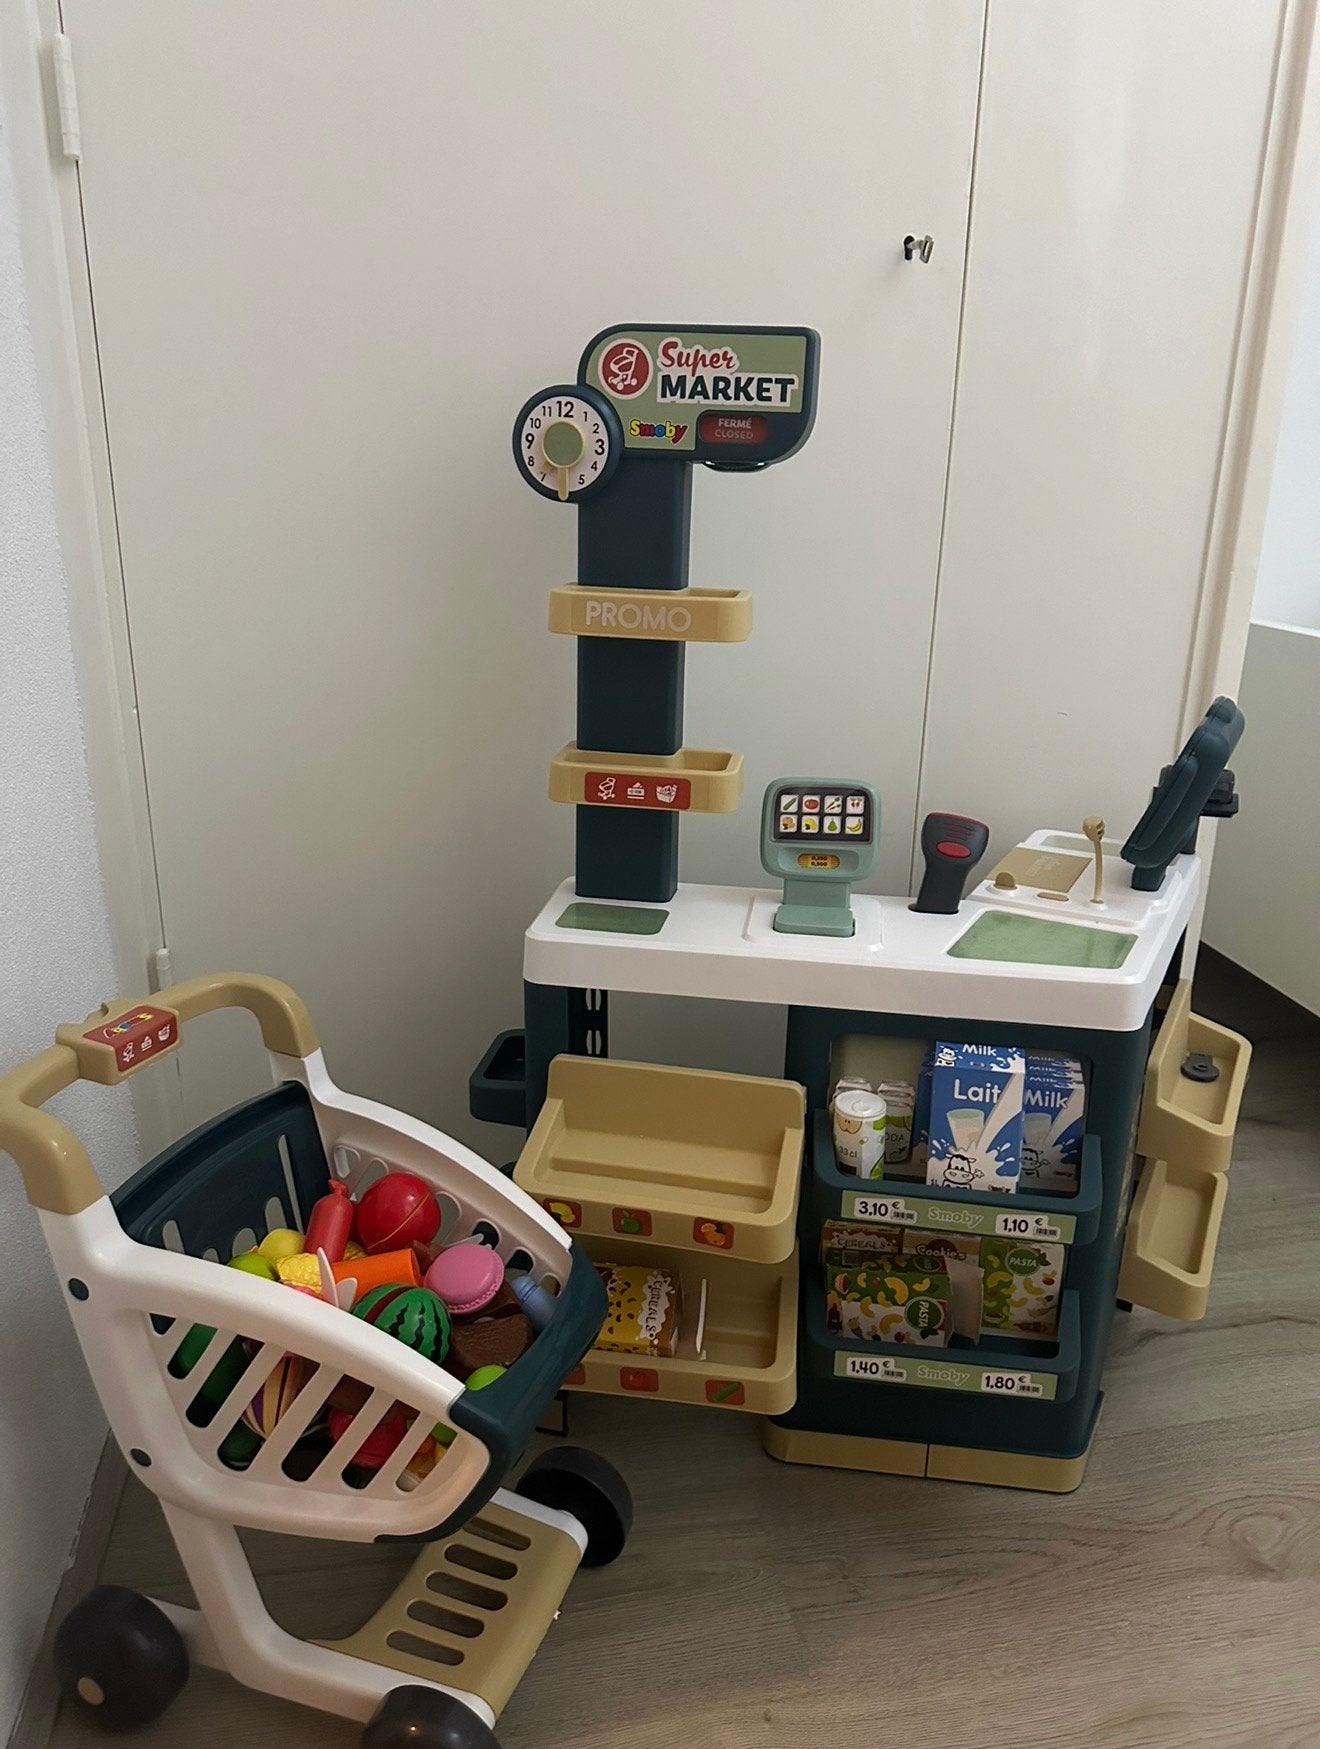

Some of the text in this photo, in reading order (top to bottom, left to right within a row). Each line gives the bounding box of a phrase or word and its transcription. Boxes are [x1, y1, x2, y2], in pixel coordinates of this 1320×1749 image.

[661, 341, 735, 377] Super
[660, 374, 795, 403] MARKET
[542, 405, 552, 417] 11
[556, 400, 574, 418] 12
[583, 411, 588, 422] 1
[530, 417, 541, 429] 10
[592, 423, 600, 434] 2
[718, 417, 752, 429] FERMÉ
[629, 419, 689, 444] Smoby
[714, 428, 754, 440] CLOSED
[525, 433, 535, 450] 9
[595, 438, 605, 456] 3
[527, 456, 535, 467] 8
[590, 461, 598, 471] 4
[578, 474, 585, 485] 5
[585, 600, 693, 633] PROMO
[962, 1043, 997, 1057] Milk
[954, 1078, 1002, 1104] Lait
[1024, 1088, 1068, 1109] Milk
[892, 1201, 900, 1210] €
[927, 1206, 984, 1227] Smoby
[1034, 1217, 1044, 1226] €
[1009, 1257, 1038, 1267] PASTA
[918, 1300, 930, 1328] PASTA
[882, 1359, 891, 1368] €
[917, 1366, 970, 1386] Smoby
[1018, 1374, 1027, 1384] €
